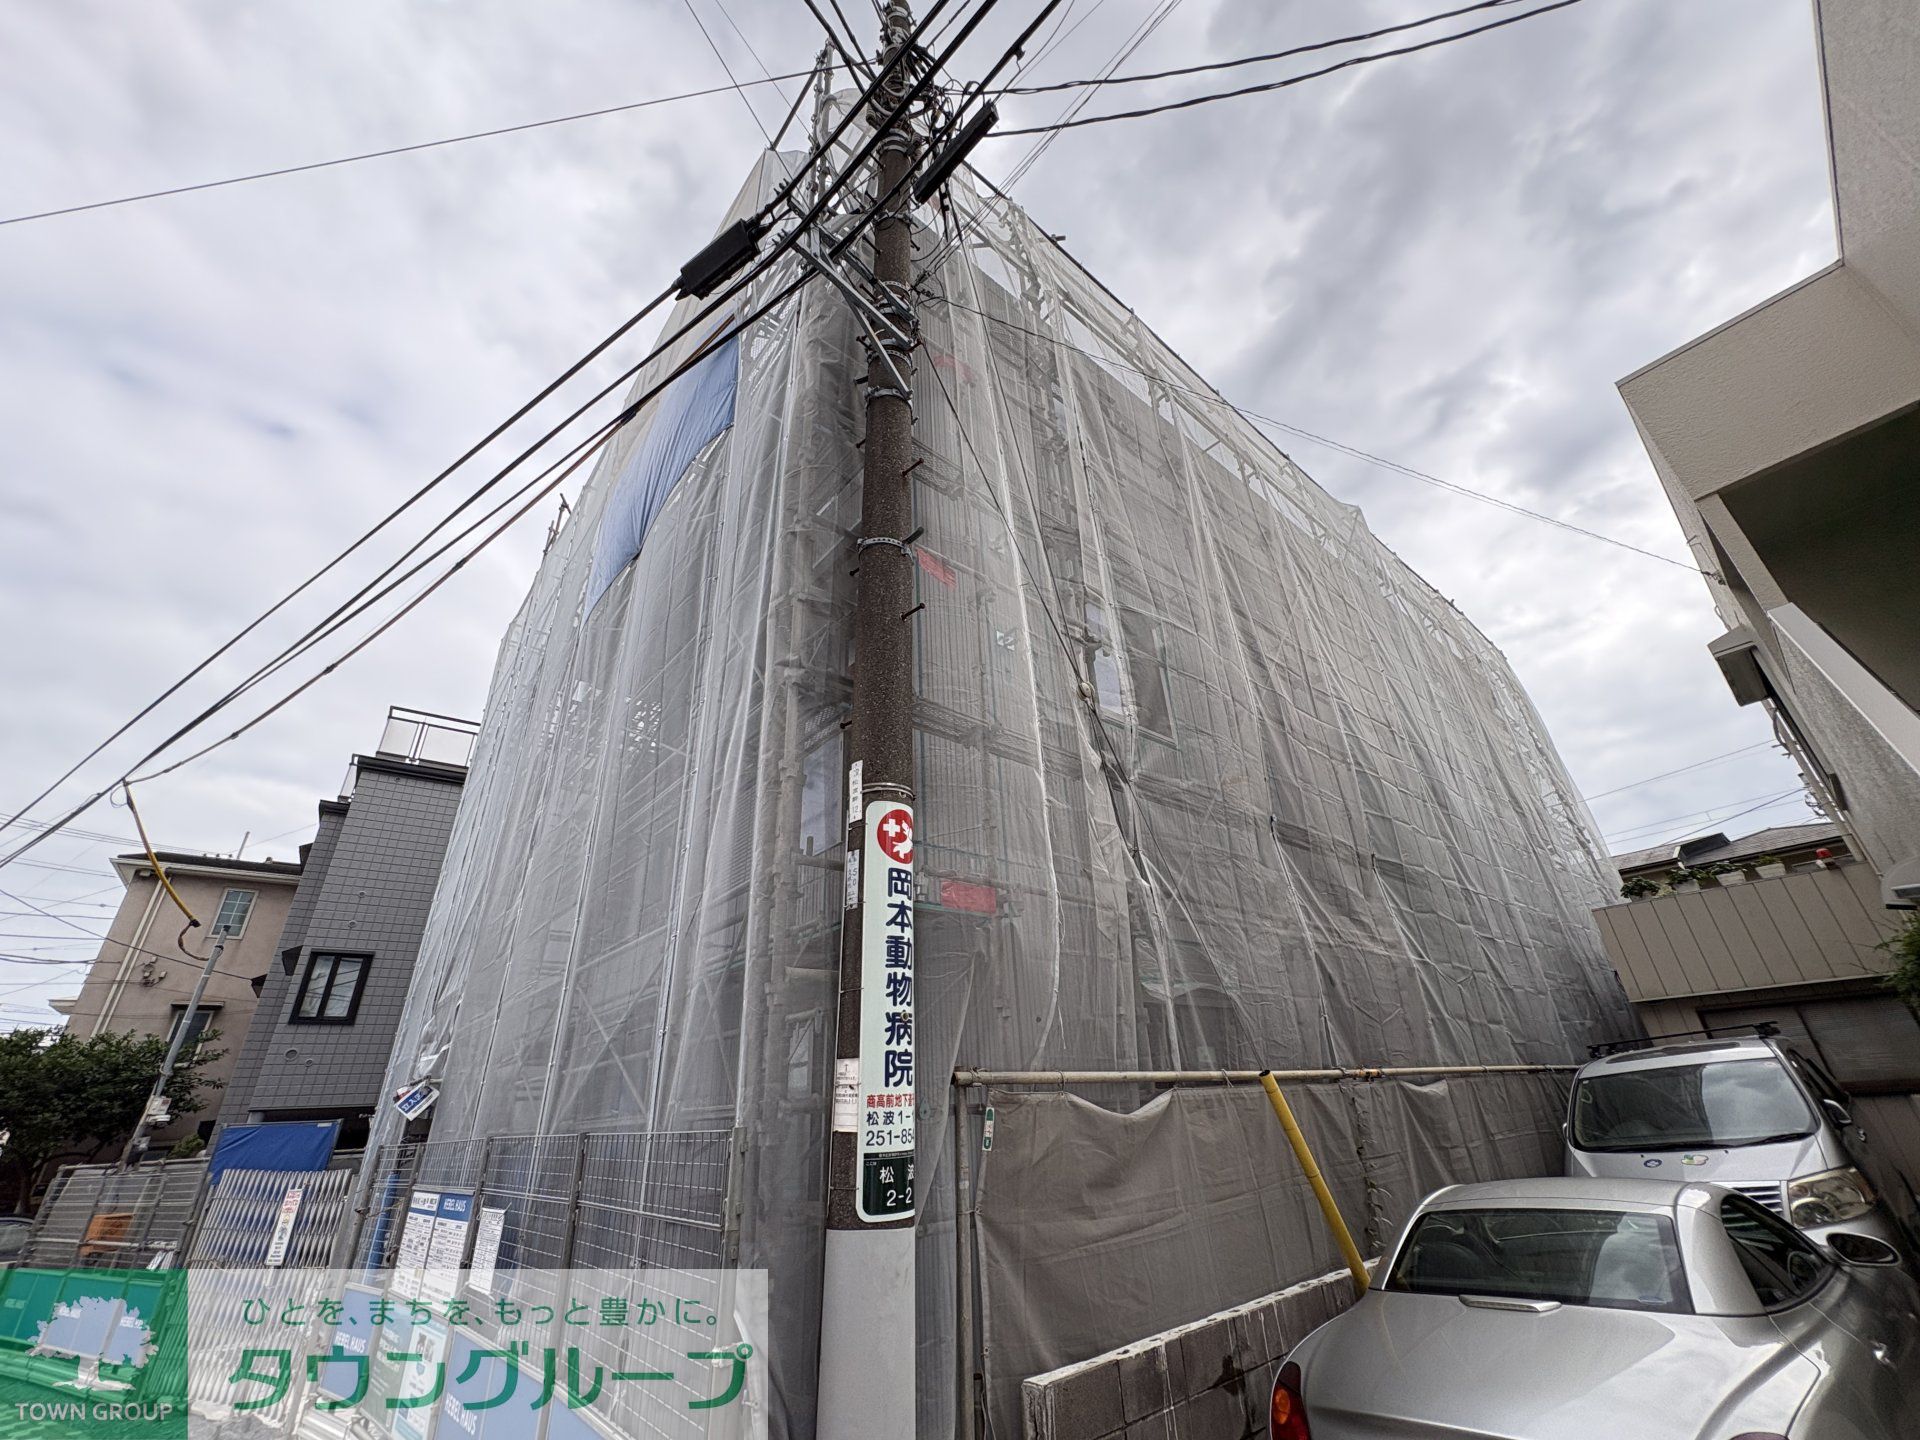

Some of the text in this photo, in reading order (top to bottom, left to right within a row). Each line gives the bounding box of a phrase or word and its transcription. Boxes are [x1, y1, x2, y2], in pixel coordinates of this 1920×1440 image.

[884, 867, 913, 1088] 岡本動物病院
